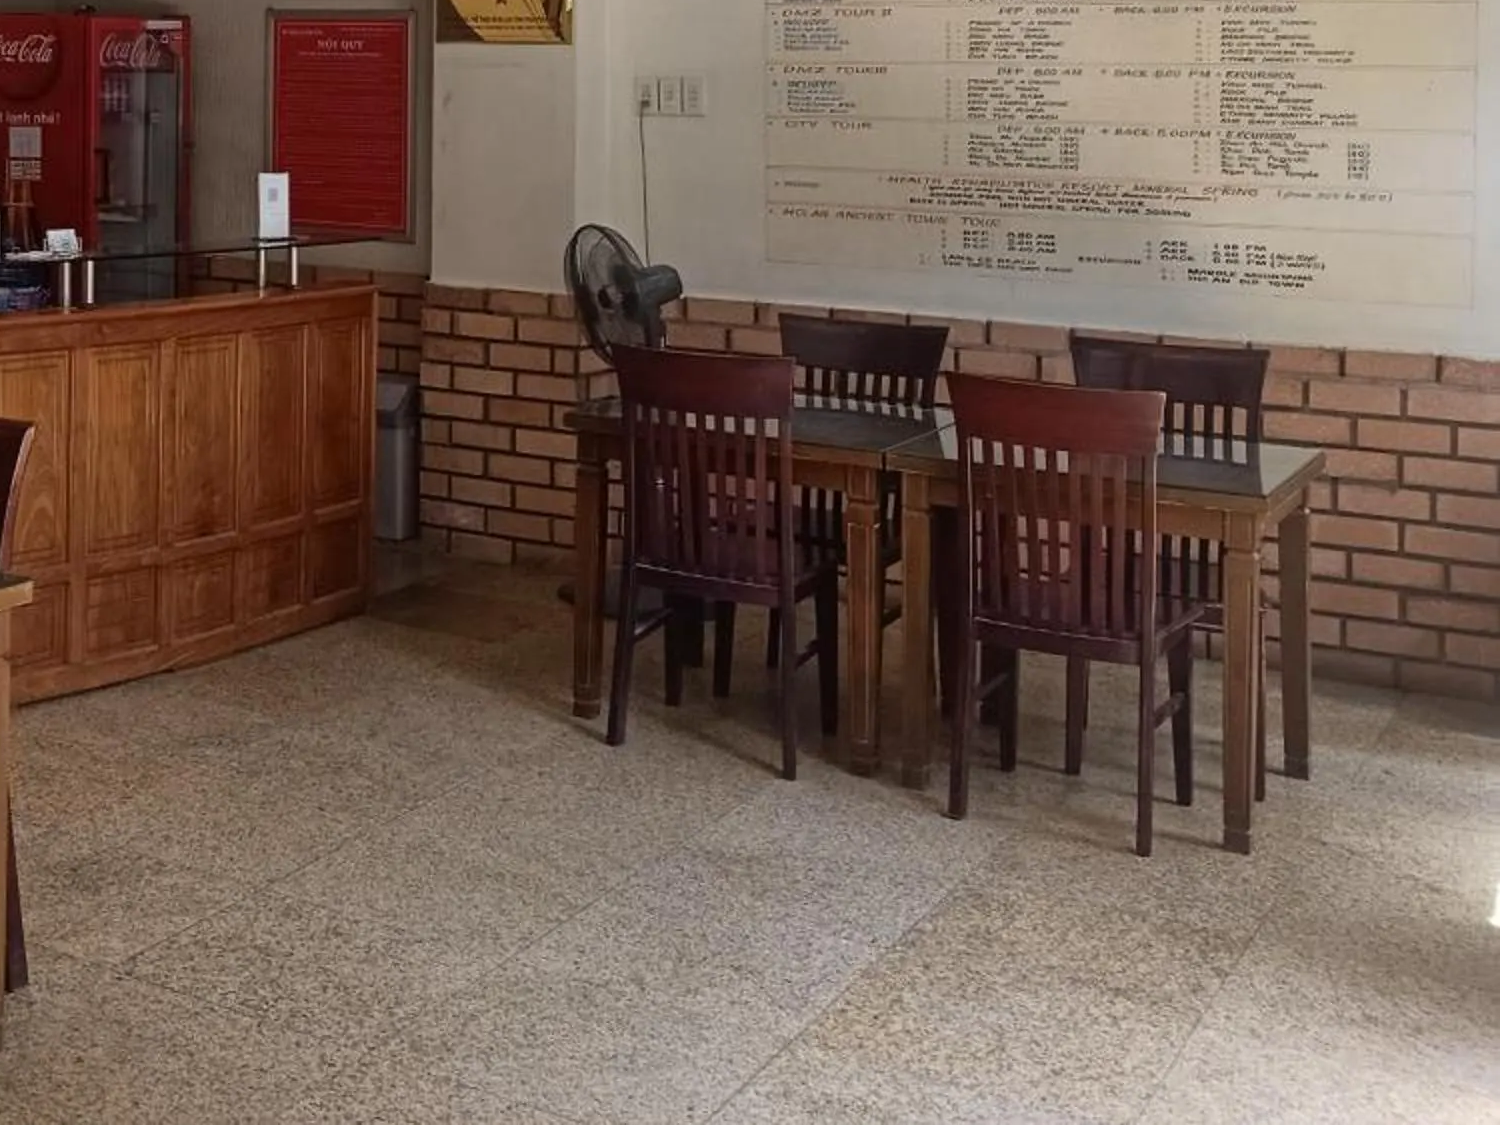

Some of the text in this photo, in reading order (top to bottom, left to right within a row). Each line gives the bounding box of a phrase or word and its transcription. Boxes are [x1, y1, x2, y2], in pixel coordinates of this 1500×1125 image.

[834, 8, 875, 17] TOUR
[1224, 4, 1297, 14] EXCURSION
[785, 120, 873, 130] CITY TOUR
[886, 175, 942, 186] HEALTH
[1132, 184, 1189, 195] MINERAL
[1202, 186, 1259, 198] SPRING
[907, 213, 948, 225] TOWN
